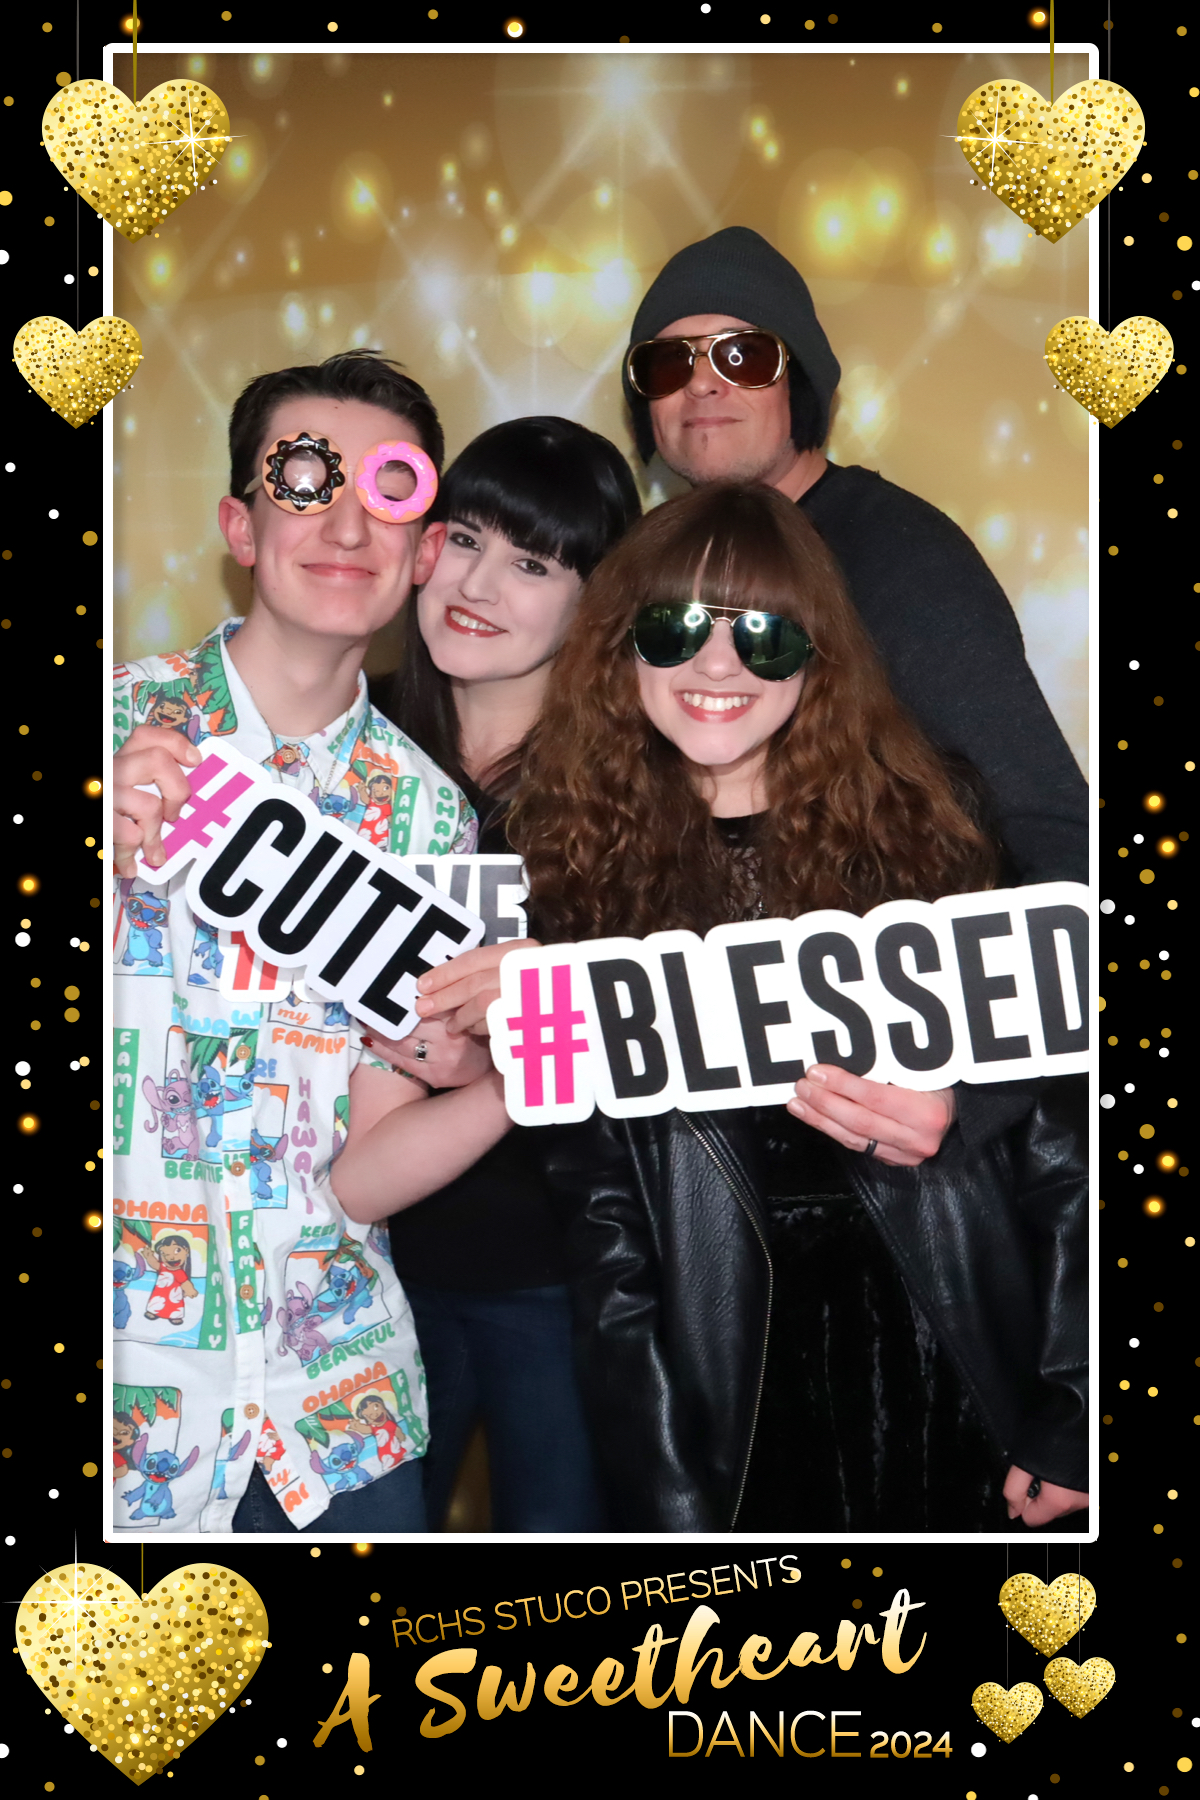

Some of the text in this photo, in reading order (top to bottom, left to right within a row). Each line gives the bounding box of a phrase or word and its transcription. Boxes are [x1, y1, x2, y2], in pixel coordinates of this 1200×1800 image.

[427, 786, 456, 856] OHAN
[140, 753, 471, 1027] #CUTE
[278, 1008, 311, 1026] my
[507, 904, 1090, 1107] #BLESSED
[272, 1027, 346, 1054] FAMILY
[113, 1198, 209, 1223] OHANA
[302, 1361, 388, 1413] OHANA
